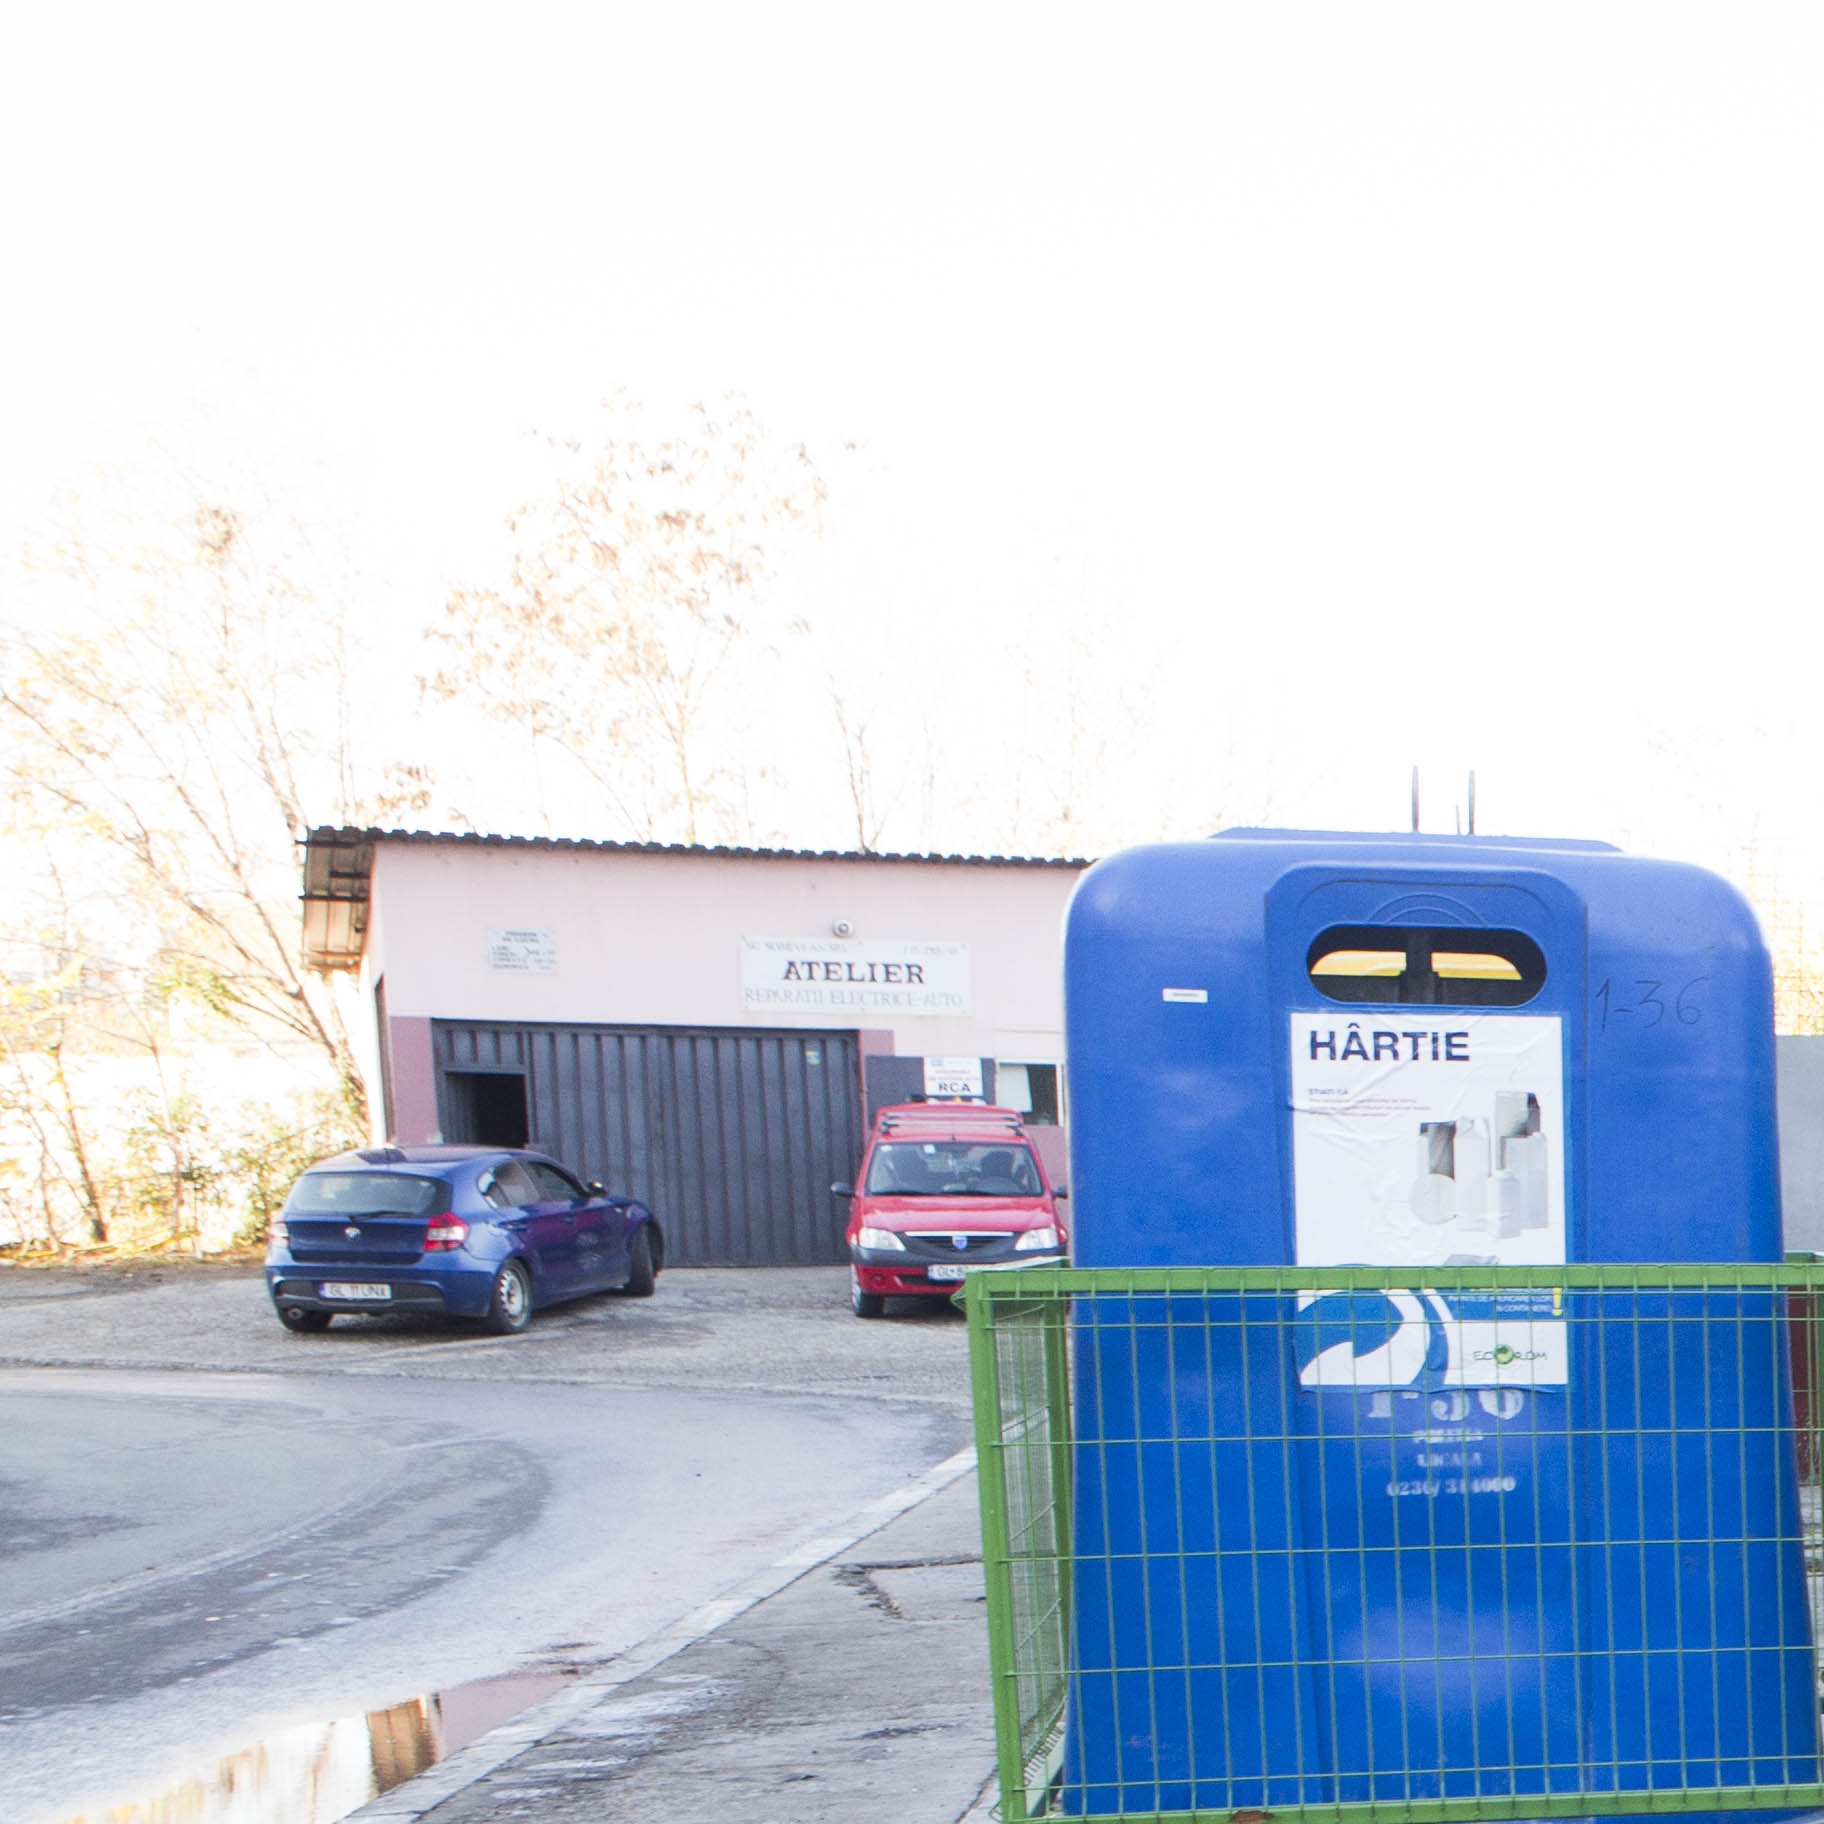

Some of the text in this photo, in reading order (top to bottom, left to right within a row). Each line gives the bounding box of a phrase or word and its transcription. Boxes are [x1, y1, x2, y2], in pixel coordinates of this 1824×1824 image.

[783, 960, 925, 984] ATELIER
[1595, 976, 1706, 1032] 1-36
[1309, 1022, 1471, 1062] HÂRTIE
[938, 1082, 971, 1092] RCA
